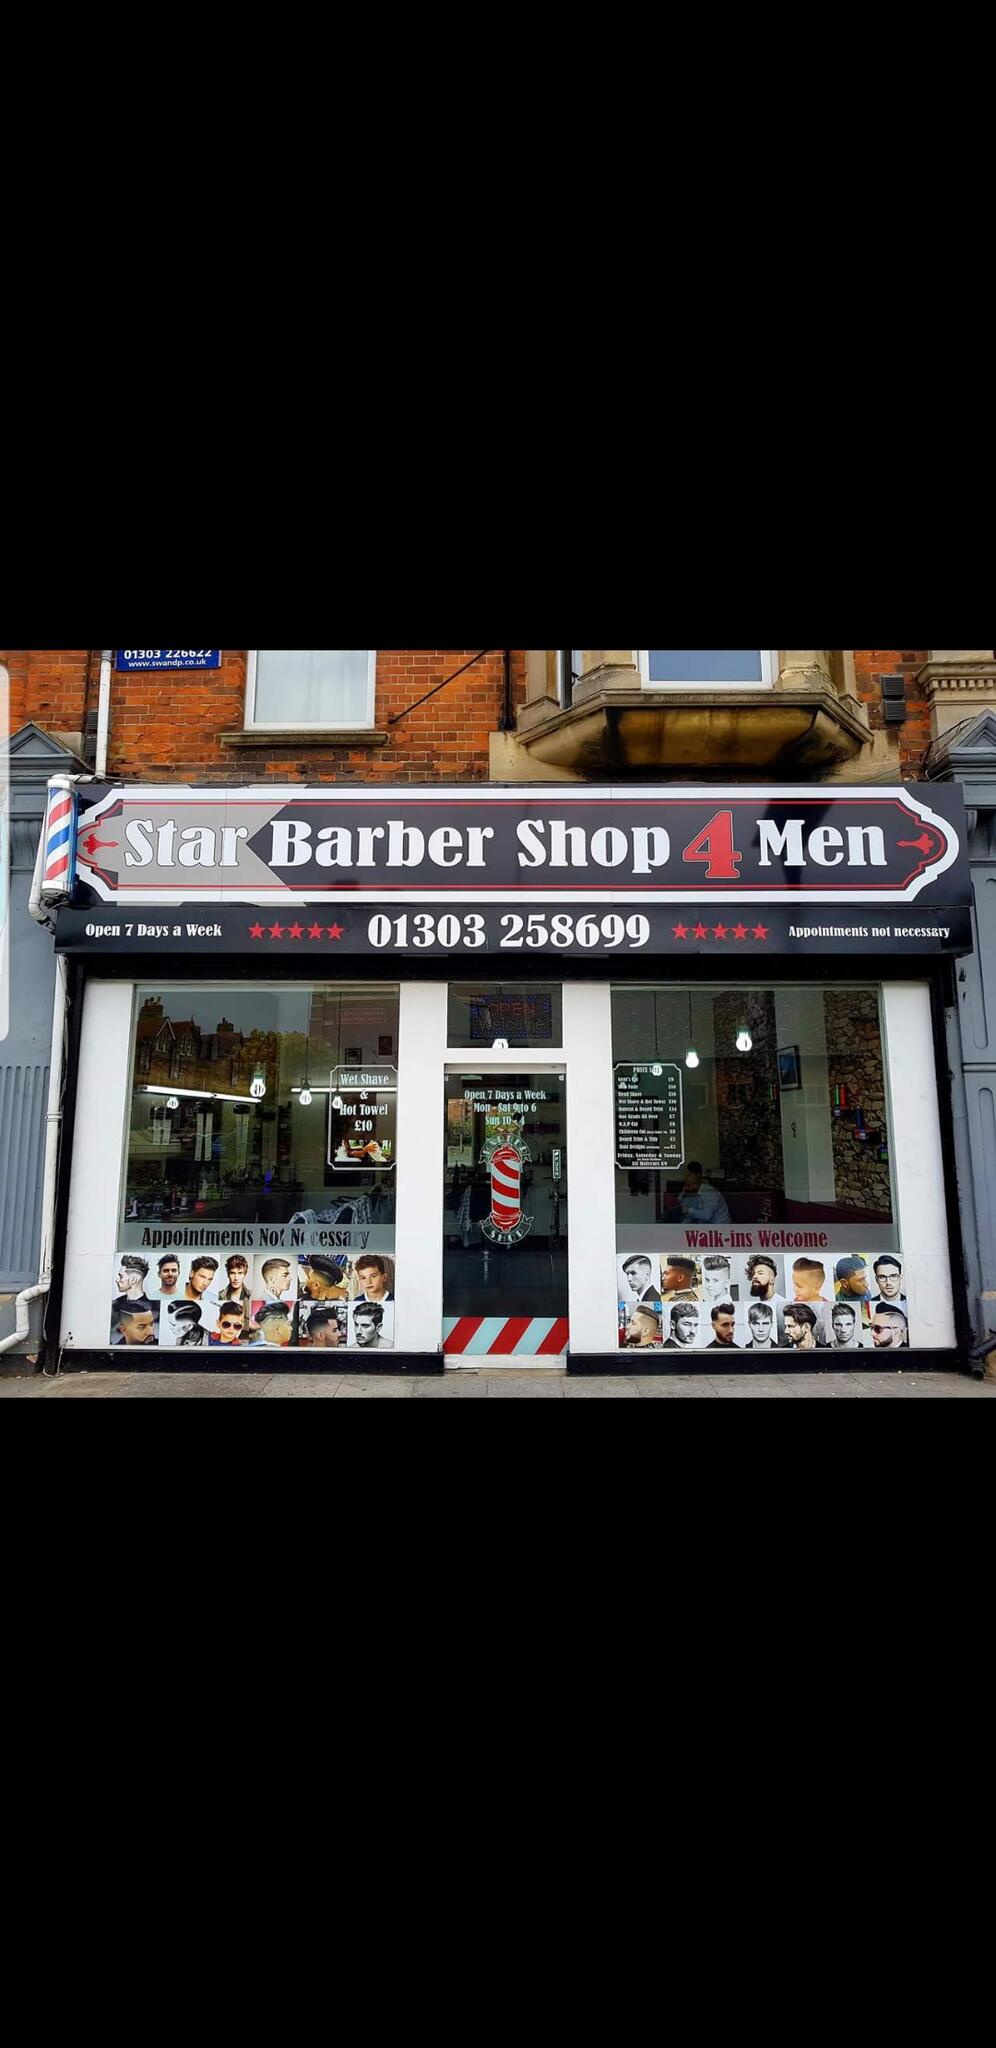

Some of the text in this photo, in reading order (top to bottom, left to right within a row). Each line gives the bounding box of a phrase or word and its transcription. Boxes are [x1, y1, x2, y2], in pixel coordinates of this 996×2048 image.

[124, 649, 161, 659] 01303
[128, 658, 207, 668] www.swandp.co.uk
[124, 809, 888, 880] Star Barber Shop 4 Men
[85, 923, 222, 940] Open 7 Days a Week
[367, 913, 651, 949] 01303 258699
[788, 925, 950, 941] Appointments not necessary
[340, 1073, 389, 1085] Wet Shave
[360, 1088, 369, 1100] &
[464, 1090, 486, 1100] Open
[487, 1090, 493, 1099] 7
[495, 1090, 514, 1101] Days
[524, 1090, 547, 1100] Week
[339, 1103, 388, 1116] Hot Towel
[473, 1103, 491, 1112] Mon
[498, 1103, 511, 1112] Sat
[531, 1103, 537, 1112] 6
[354, 1120, 373, 1132] £10
[485, 1116, 500, 1125] Sun
[502, 1116, 511, 1125] 10
[141, 1227, 254, 1248] Appointments
[259, 1227, 285, 1248] Not
[490, 1229, 524, 1242] SHOP
[685, 1229, 828, 1248] Walk-ins Welcome
